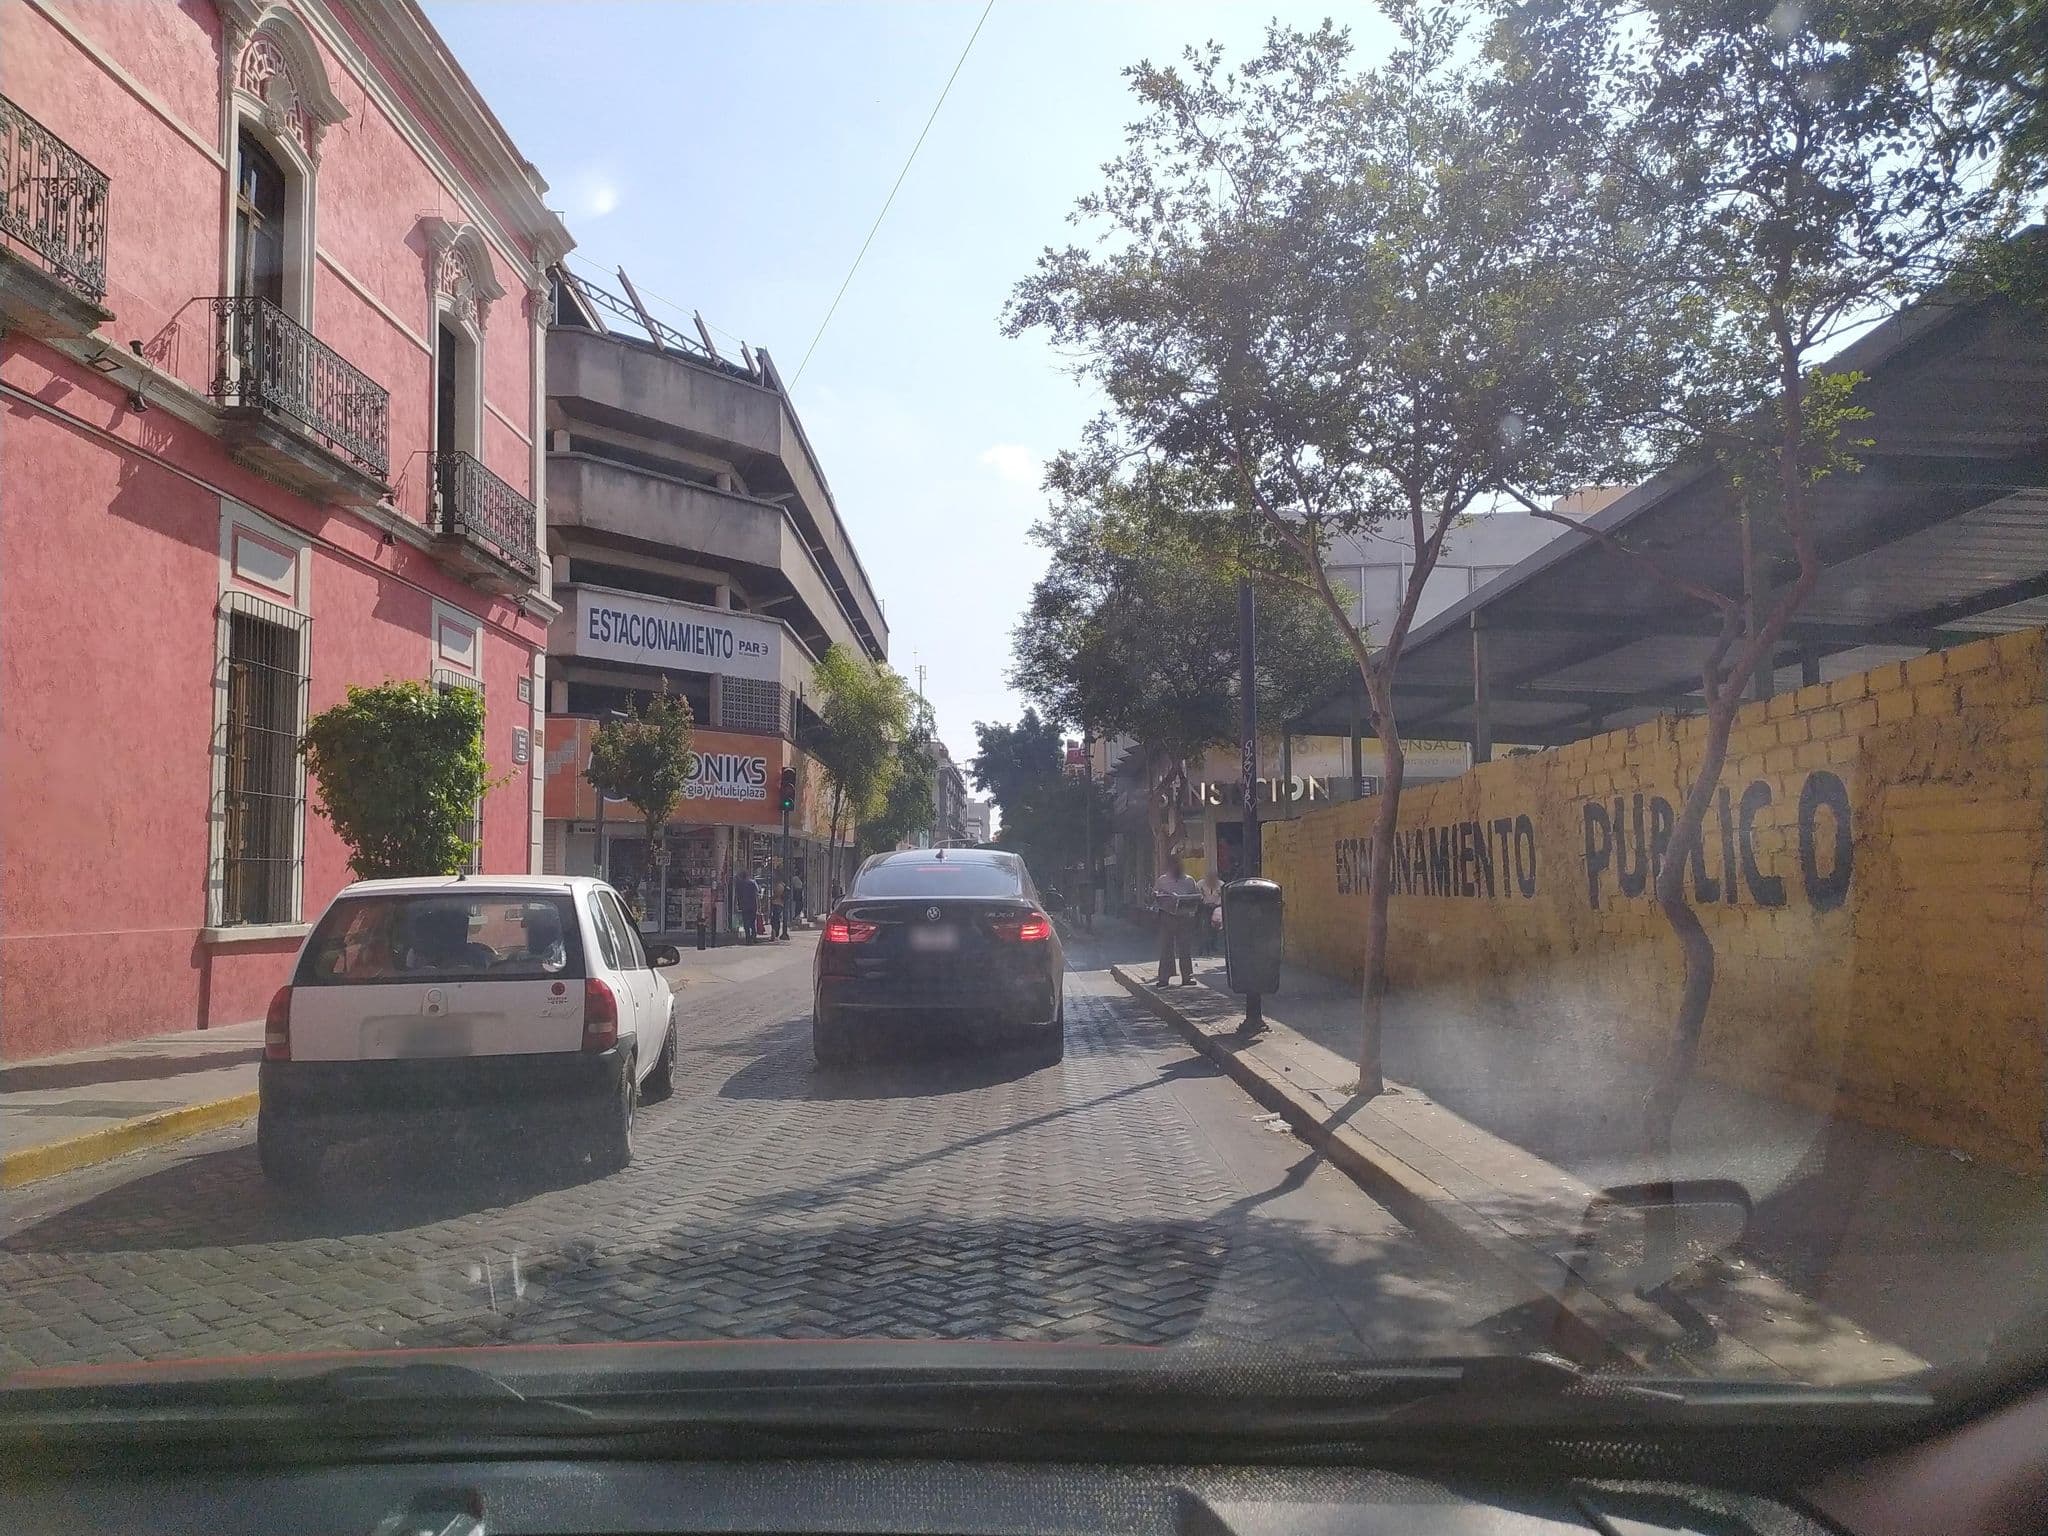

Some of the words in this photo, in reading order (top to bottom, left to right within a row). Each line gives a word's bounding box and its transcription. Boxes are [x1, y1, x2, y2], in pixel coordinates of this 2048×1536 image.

[589, 607, 734, 659] ESTACIONAMIENTO
[705, 785, 713, 799] y
[715, 784, 766, 801] Multiplaza
